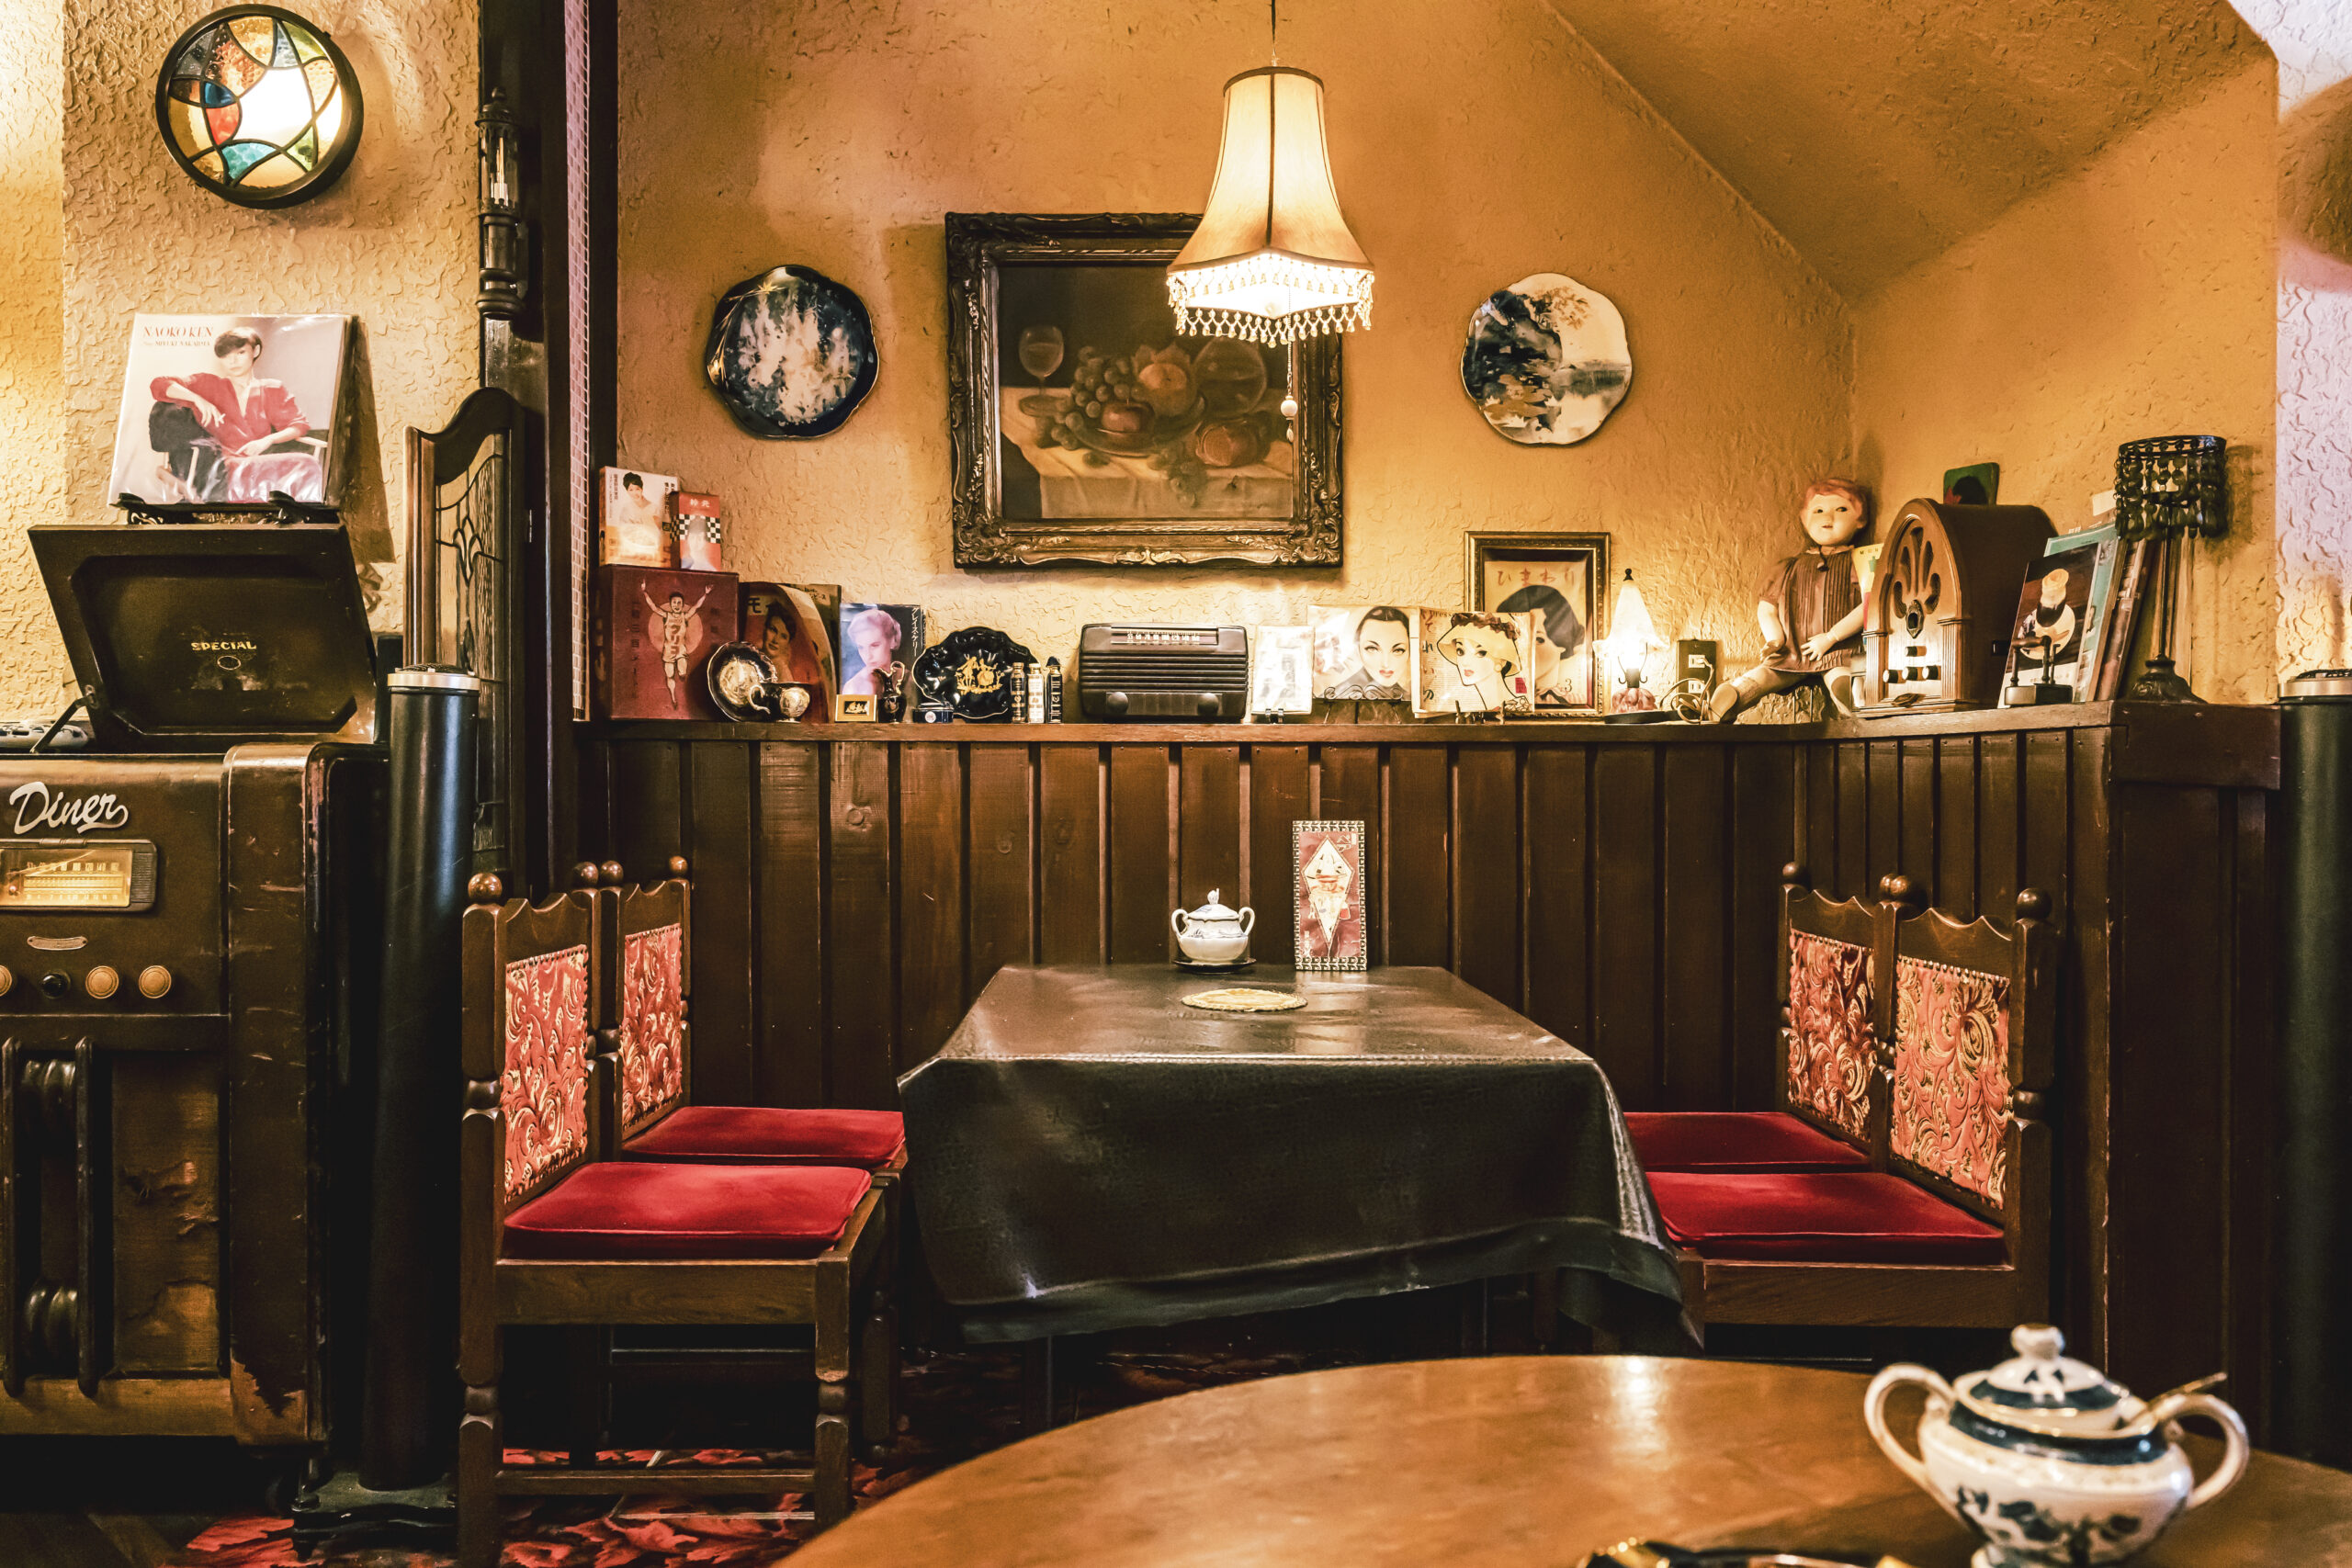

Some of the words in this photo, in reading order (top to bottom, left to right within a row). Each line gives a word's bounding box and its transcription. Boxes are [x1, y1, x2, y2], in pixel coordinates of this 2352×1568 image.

[143, 325, 187, 338] NAOKO
[189, 325, 213, 338] KEN
[1497, 567, 1576, 587] ひまわり
[190, 640, 258, 651] SPECIAL
[1564, 677, 1573, 694] 3
[9, 781, 129, 835] Diner
